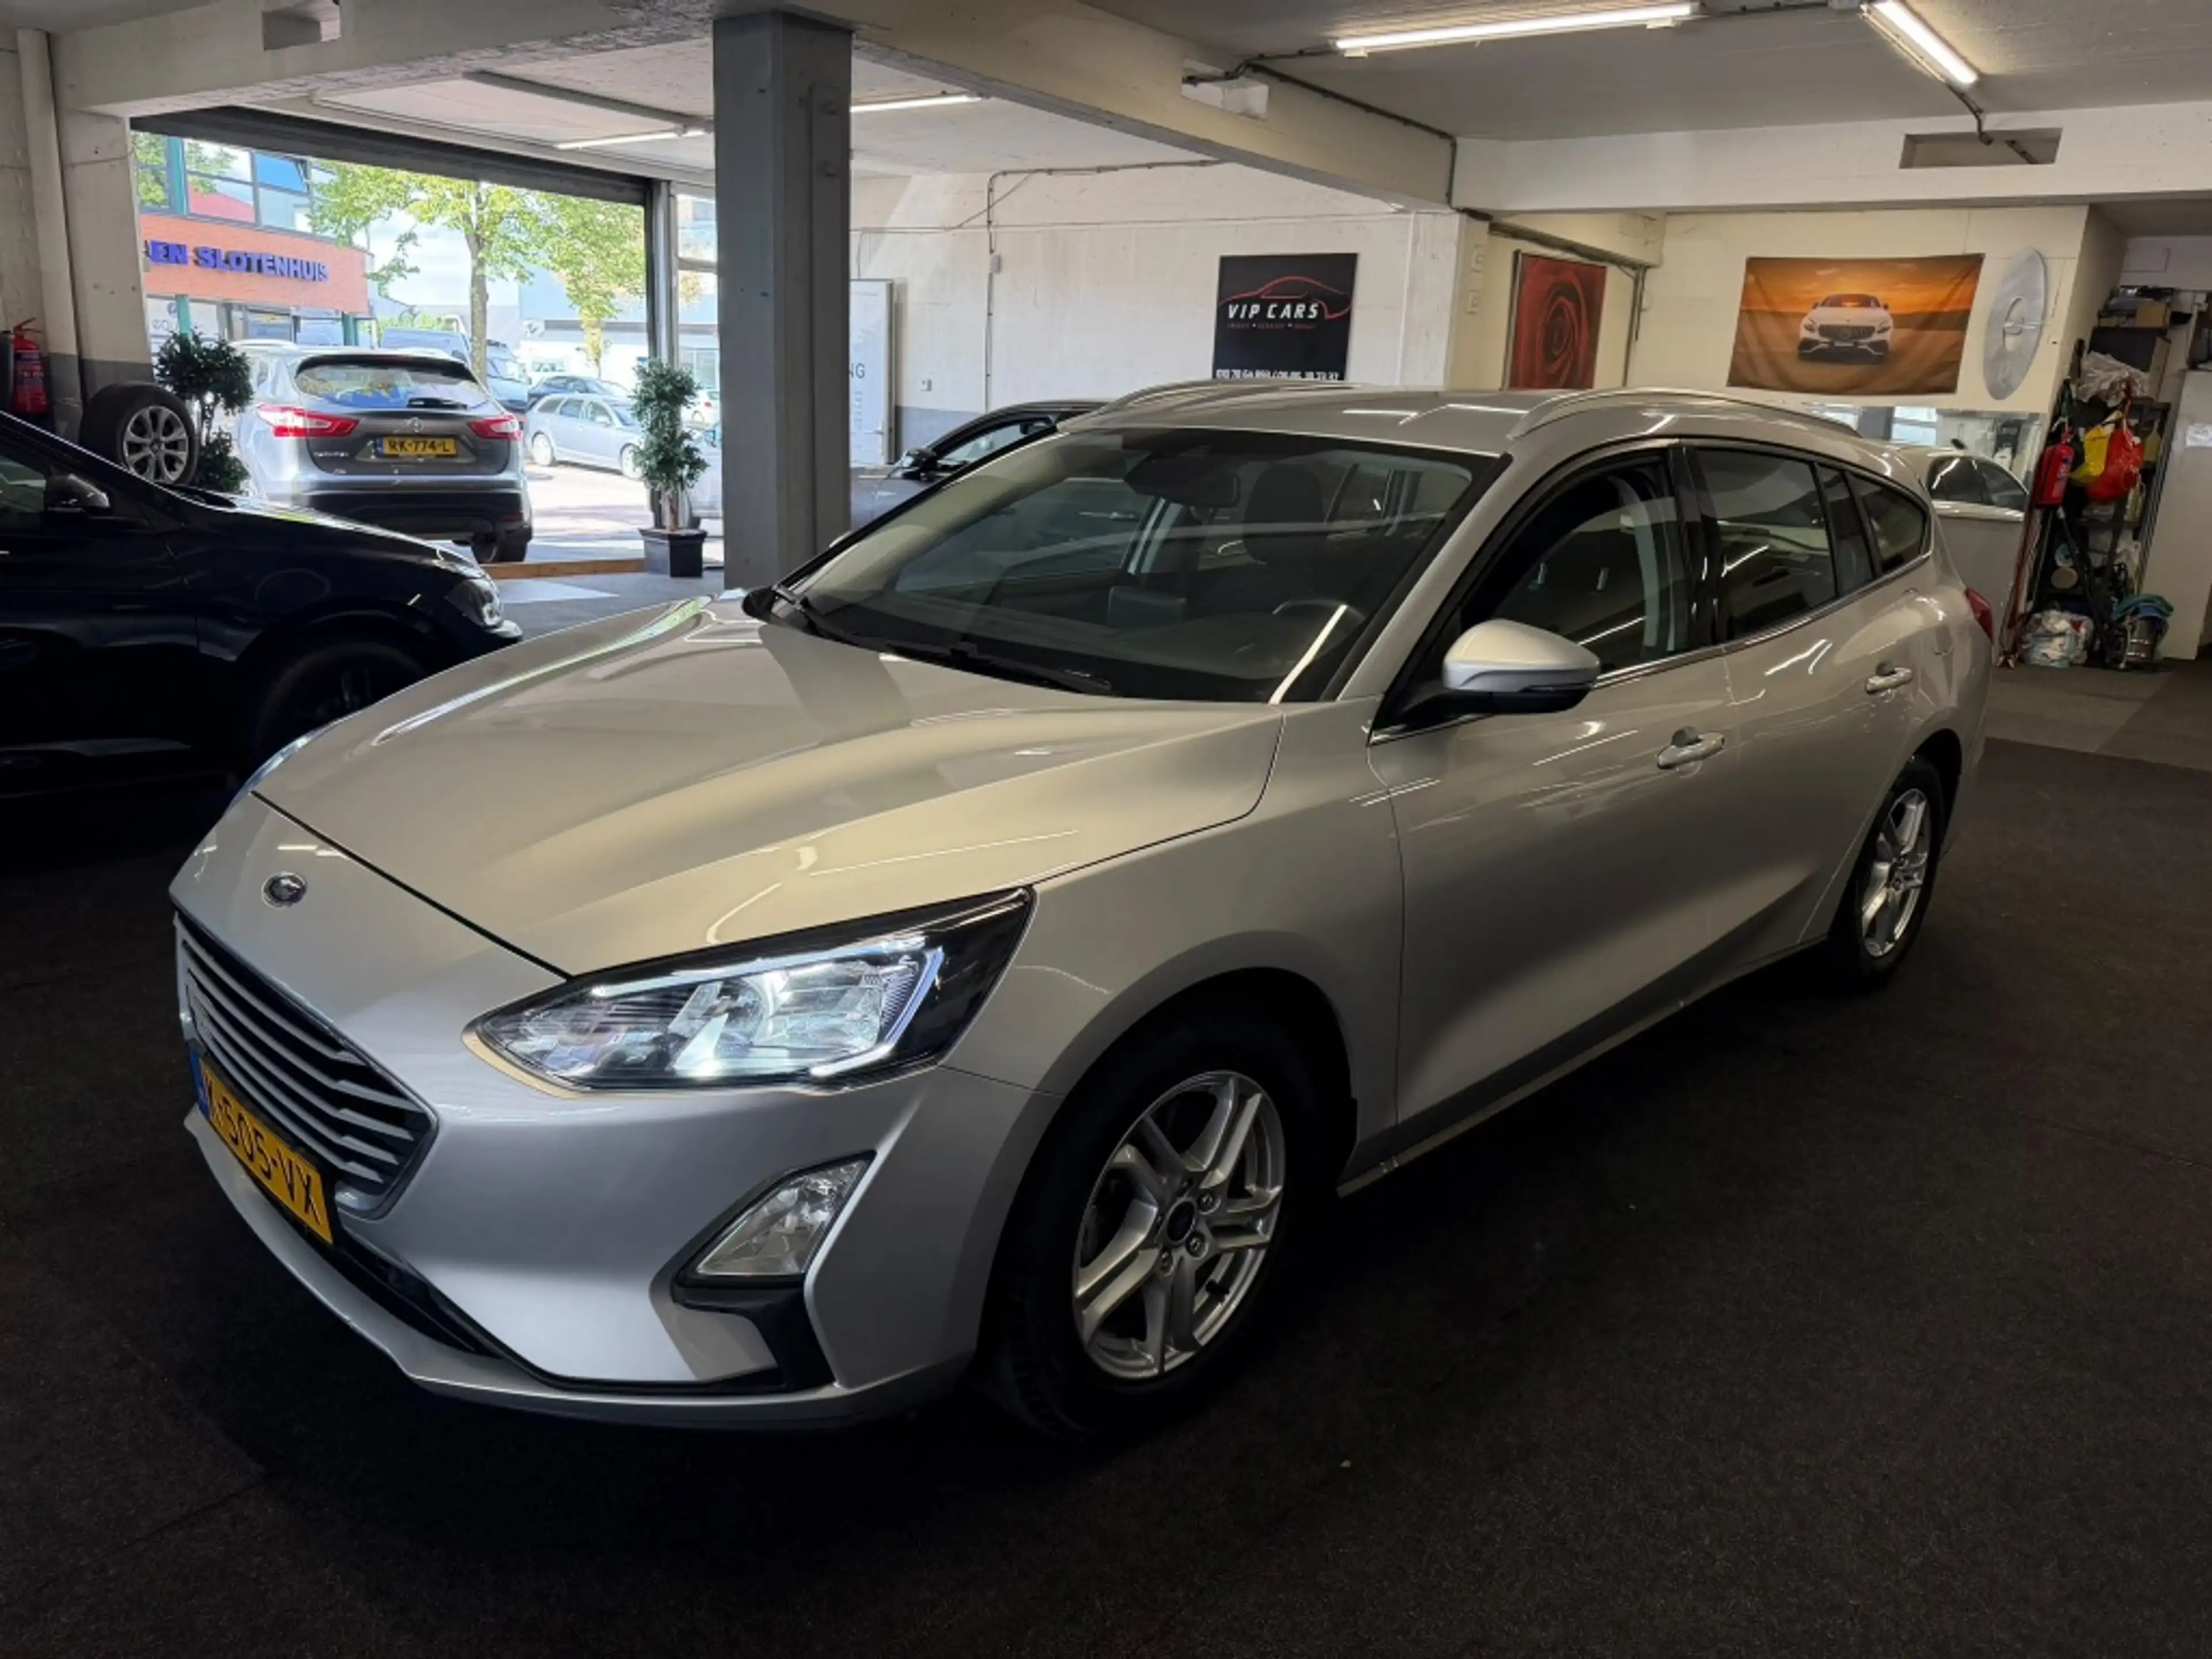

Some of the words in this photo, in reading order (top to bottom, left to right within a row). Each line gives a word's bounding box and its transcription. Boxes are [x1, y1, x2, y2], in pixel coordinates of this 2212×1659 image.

[195, 246, 329, 282] SLOTENHUIS
[1228, 304, 1260, 319] VIP
[1266, 302, 1319, 319] CARS
[388, 440, 451, 453] RK-774-L
